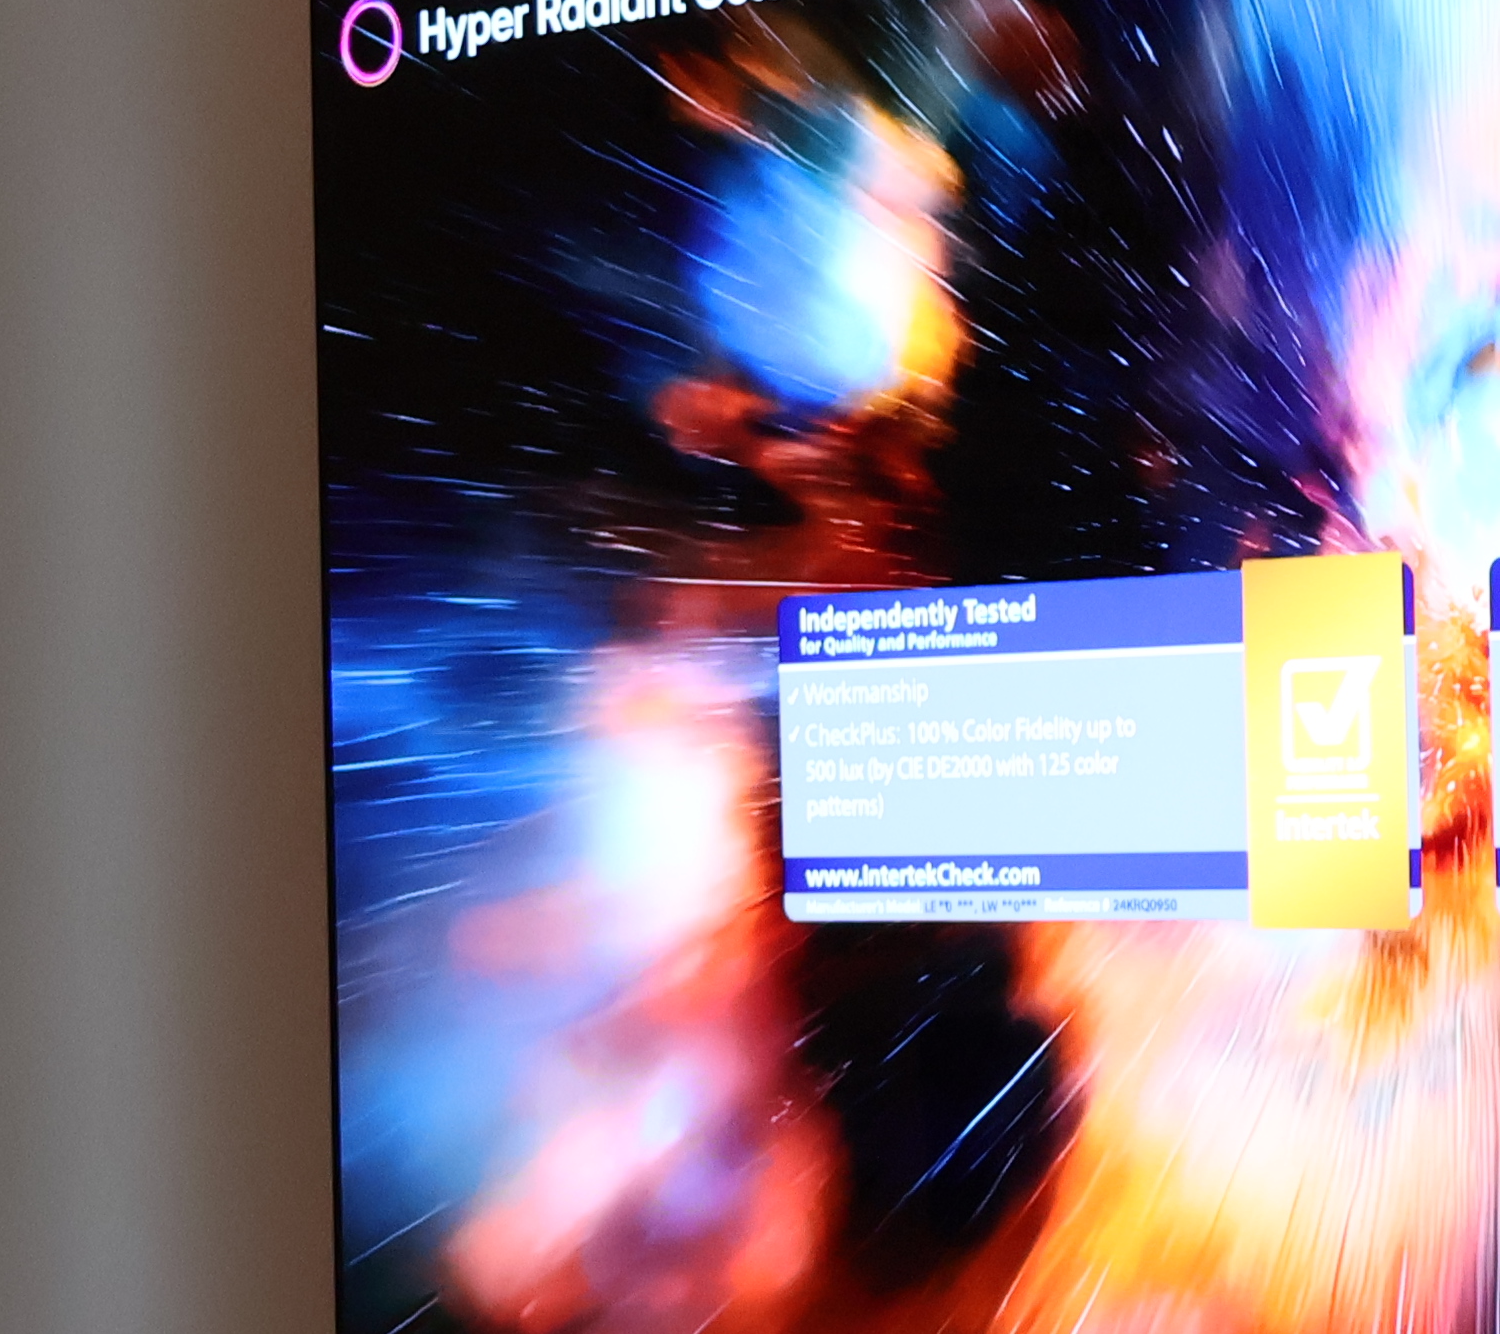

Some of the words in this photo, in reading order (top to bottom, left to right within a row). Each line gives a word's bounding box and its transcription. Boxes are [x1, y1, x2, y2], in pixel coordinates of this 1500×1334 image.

[420, 4, 529, 59] Hyper
[800, 599, 958, 637] Independently
[963, 594, 1036, 624] Tested
[804, 679, 928, 705] Workmanship
[963, 718, 1011, 742] Color
[1016, 716, 1082, 742] Fidelity
[1087, 720, 1112, 741] up
[1116, 716, 1136, 737] to
[806, 862, 1040, 887] www.IntertekCheck.com
